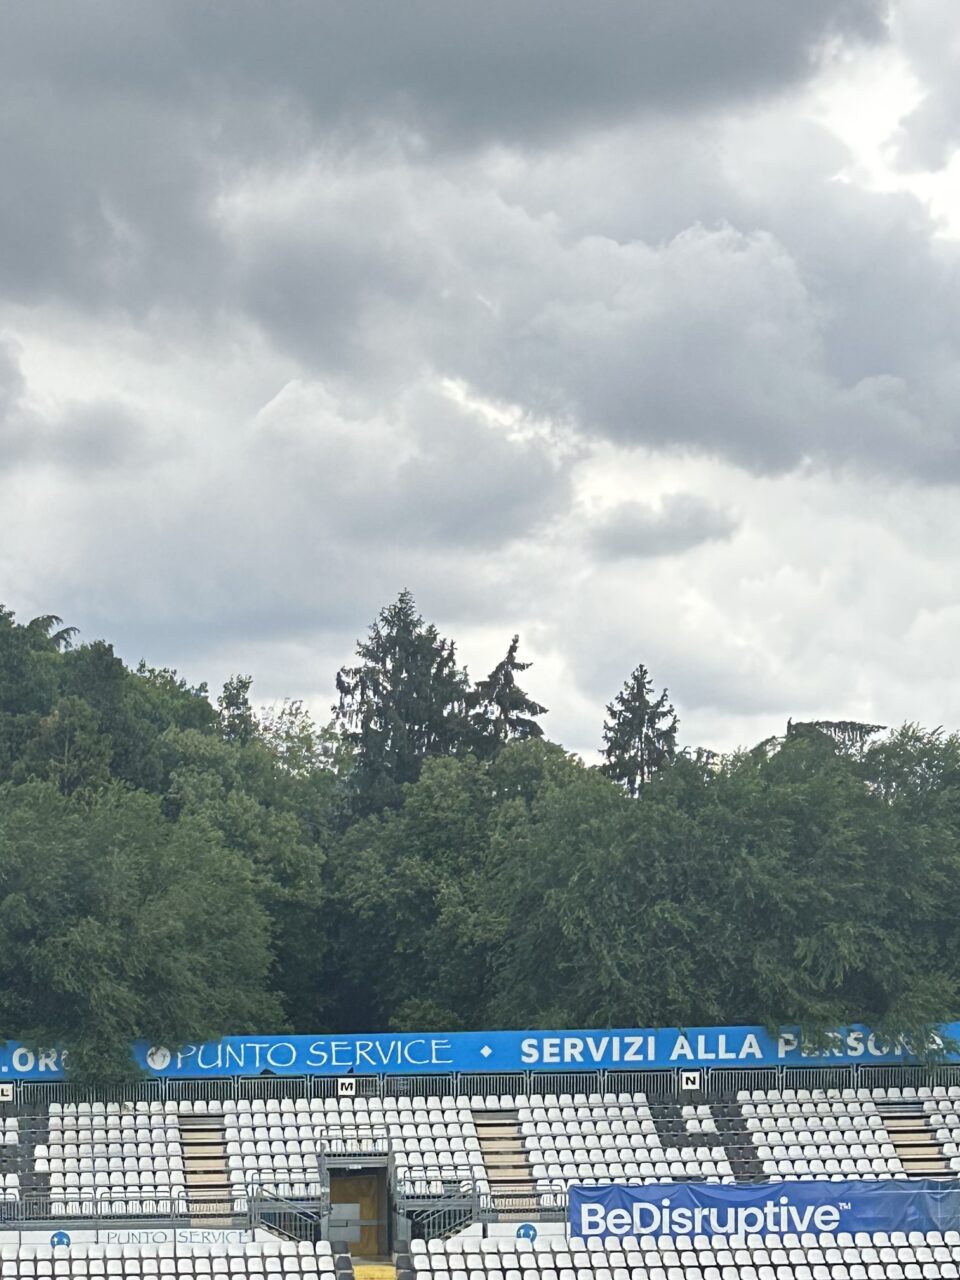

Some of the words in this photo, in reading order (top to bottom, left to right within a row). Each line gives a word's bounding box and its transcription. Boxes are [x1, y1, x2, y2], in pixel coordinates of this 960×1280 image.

[305, 1038, 453, 1067] SERVICE
[520, 1036, 656, 1064] SERVIZI
[669, 1033, 764, 1061] ALLA
[340, 1082, 354, 1091] M
[685, 1075, 696, 1086] N
[107, 1231, 168, 1245] PUNTO
[178, 1230, 250, 1244] SERVICE
